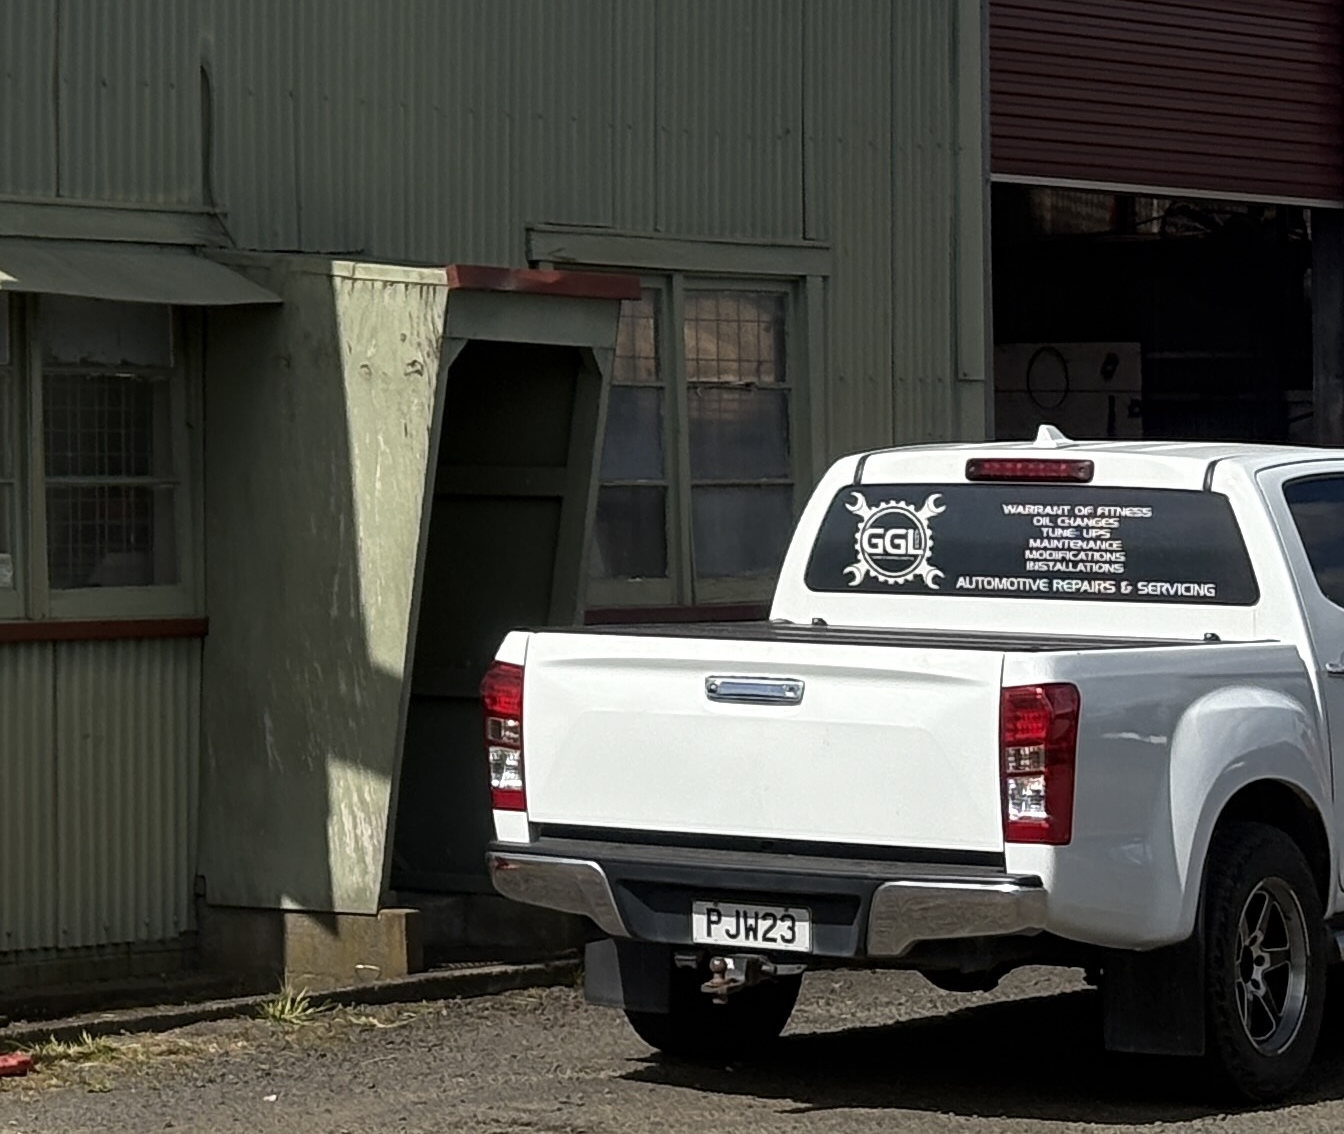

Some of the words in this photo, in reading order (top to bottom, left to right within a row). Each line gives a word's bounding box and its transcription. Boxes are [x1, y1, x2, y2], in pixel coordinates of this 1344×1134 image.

[1002, 504, 1071, 516] WARRANT
[1074, 505, 1094, 516] OF
[1097, 506, 1153, 518] FITNESS
[1032, 516, 1055, 527] OIL
[1057, 517, 1120, 528] CHANGES
[862, 527, 924, 555] GGL
[1028, 538, 1123, 551] MAINTENANCE
[1024, 550, 1126, 562] MODIFICATIONS
[1026, 561, 1125, 574] INSTALLATIONS
[955, 576, 1049, 592] AUTOMOTIVE
[1052, 578, 1117, 595] REPAIRS
[1120, 580, 1133, 594] &
[1137, 581, 1217, 598] SERVICING
[705, 907, 797, 944] PJW23
